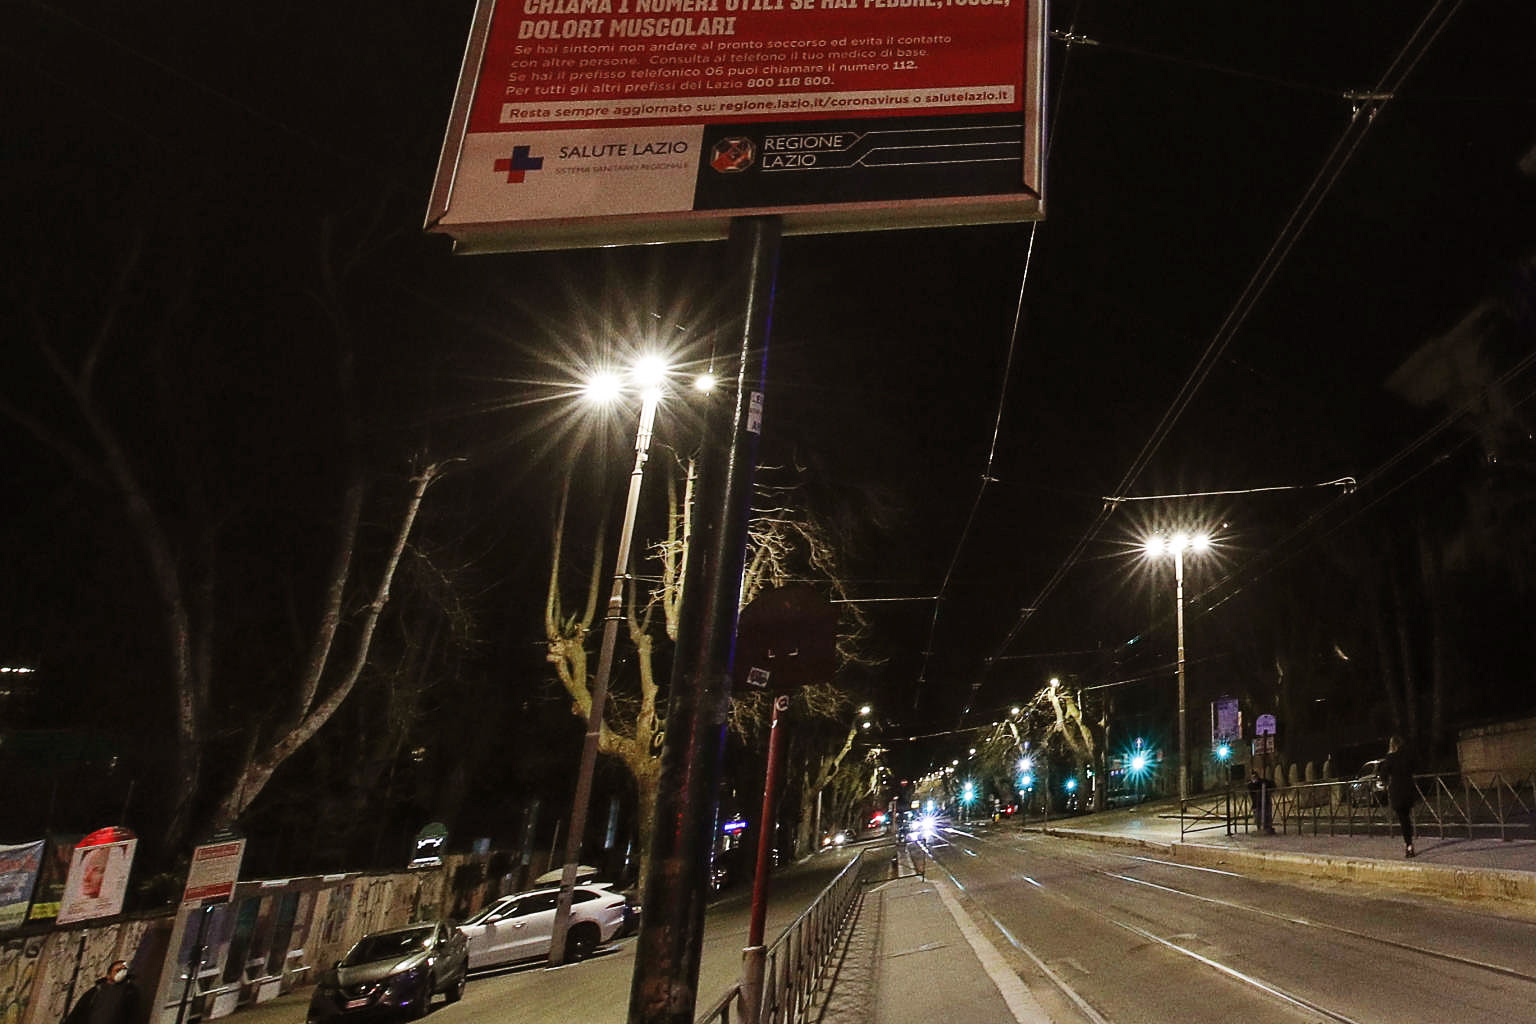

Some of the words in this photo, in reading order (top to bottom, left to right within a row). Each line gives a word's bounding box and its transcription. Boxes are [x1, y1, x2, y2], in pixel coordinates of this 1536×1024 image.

[518, 19, 605, 39] DOLORI
[609, 17, 736, 38] MUSCOLARI
[510, 107, 550, 119] Resta
[555, 106, 609, 119] sempre
[613, 103, 692, 116] aggiornato
[696, 103, 716, 112] su:
[719, 94, 910, 113] regione.lazio.it/coronavirus
[913, 96, 921, 104] o
[925, 91, 1008, 103] salutelazio.it
[559, 145, 627, 158] SALUTE
[633, 141, 688, 156] LAZIO
[764, 135, 843, 151] REGIONE
[762, 154, 816, 168] LAZIO
